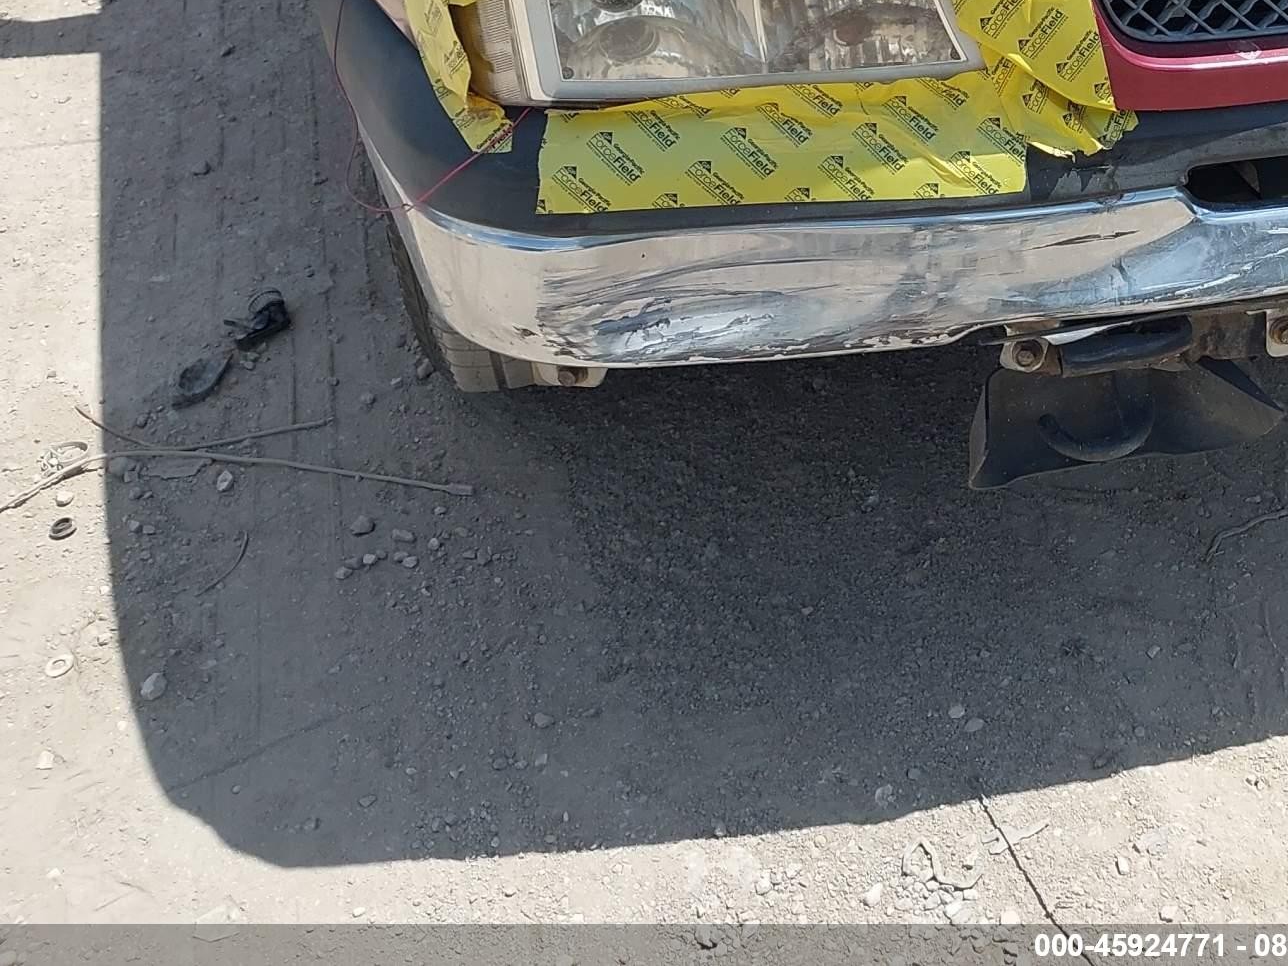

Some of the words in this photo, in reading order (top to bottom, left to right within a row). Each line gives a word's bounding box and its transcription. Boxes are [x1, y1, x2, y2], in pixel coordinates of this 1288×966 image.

[1021, 8, 1064, 57] ForceField
[885, 98, 936, 140] ForceField
[590, 134, 641, 182] ForceField
[725, 128, 774, 176] ForceField
[855, 125, 905, 171] ForceField
[555, 166, 608, 213] ForceField
[689, 161, 741, 207] ForceField
[951, 152, 1000, 195] ForceField
